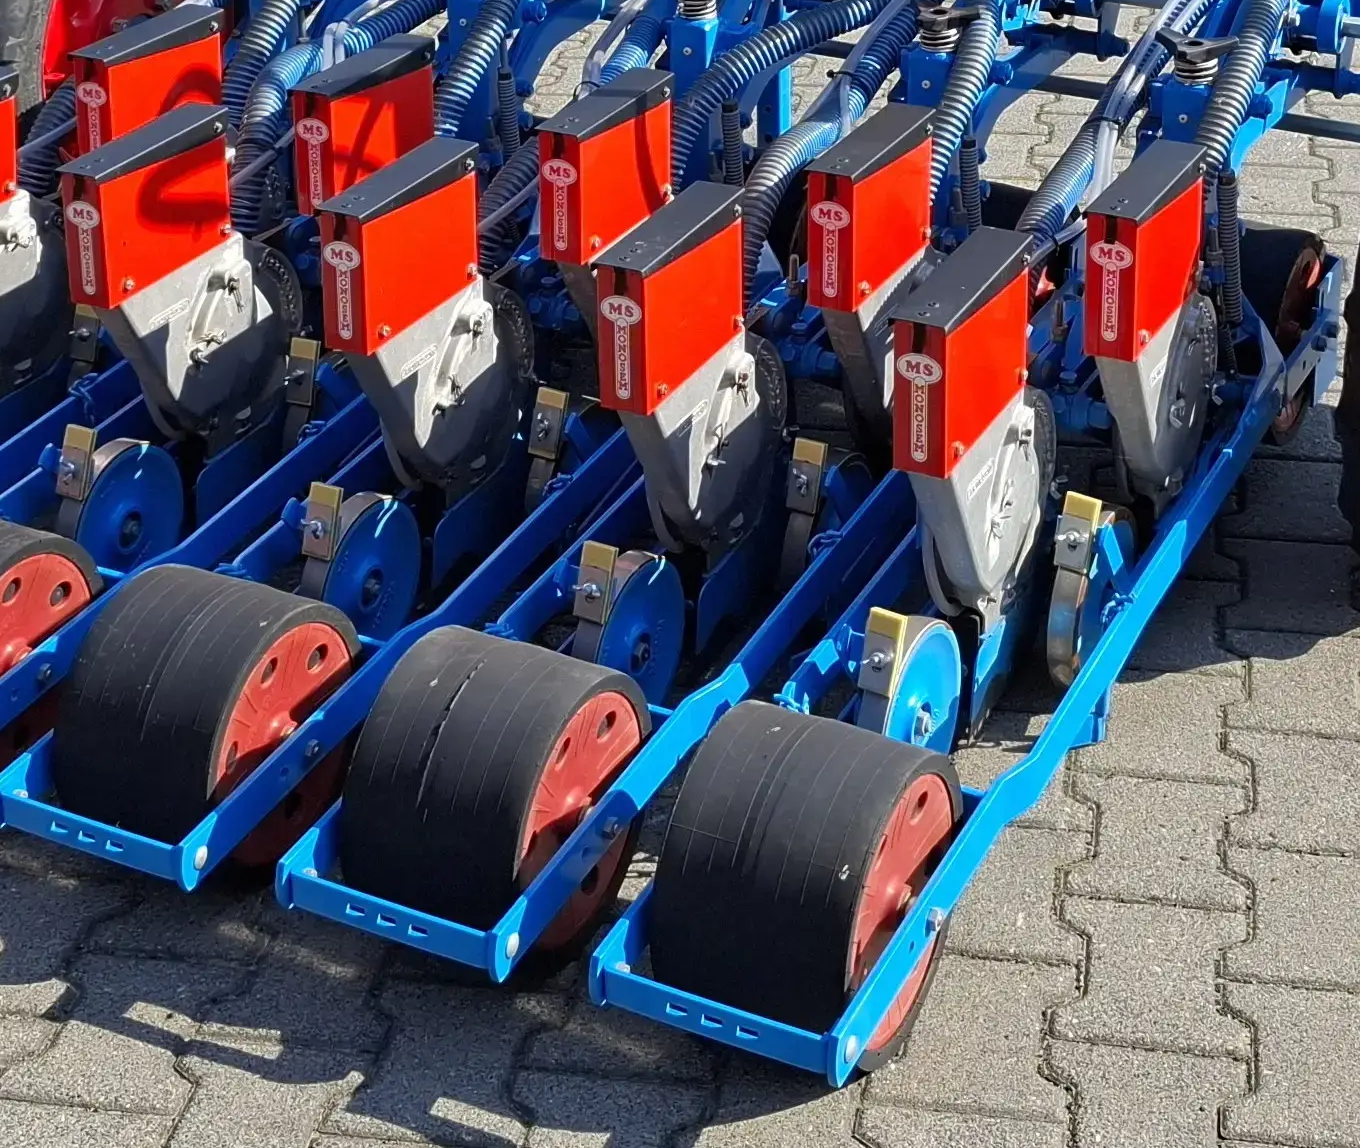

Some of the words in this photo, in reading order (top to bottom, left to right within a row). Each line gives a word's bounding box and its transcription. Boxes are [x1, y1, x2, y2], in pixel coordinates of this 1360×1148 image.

[82, 87, 102, 100] MS
[302, 124, 323, 136] MS
[310, 144, 320, 200] MONOSEM
[548, 164, 571, 178] MS
[72, 207, 94, 221] MS
[556, 184, 566, 243] MONOSEM
[818, 208, 842, 222] MS
[80, 227, 93, 288] MONOSEM
[330, 248, 354, 262] MS
[826, 228, 835, 290] MONOSEM
[1098, 246, 1125, 262] MS
[340, 269, 350, 332] MONOSEM
[1104, 268, 1116, 333] MONOSEM
[608, 302, 634, 318] MS
[616, 324, 628, 391] MONOSEM
[905, 360, 934, 376] MS
[914, 383, 924, 454] MONOSEM
